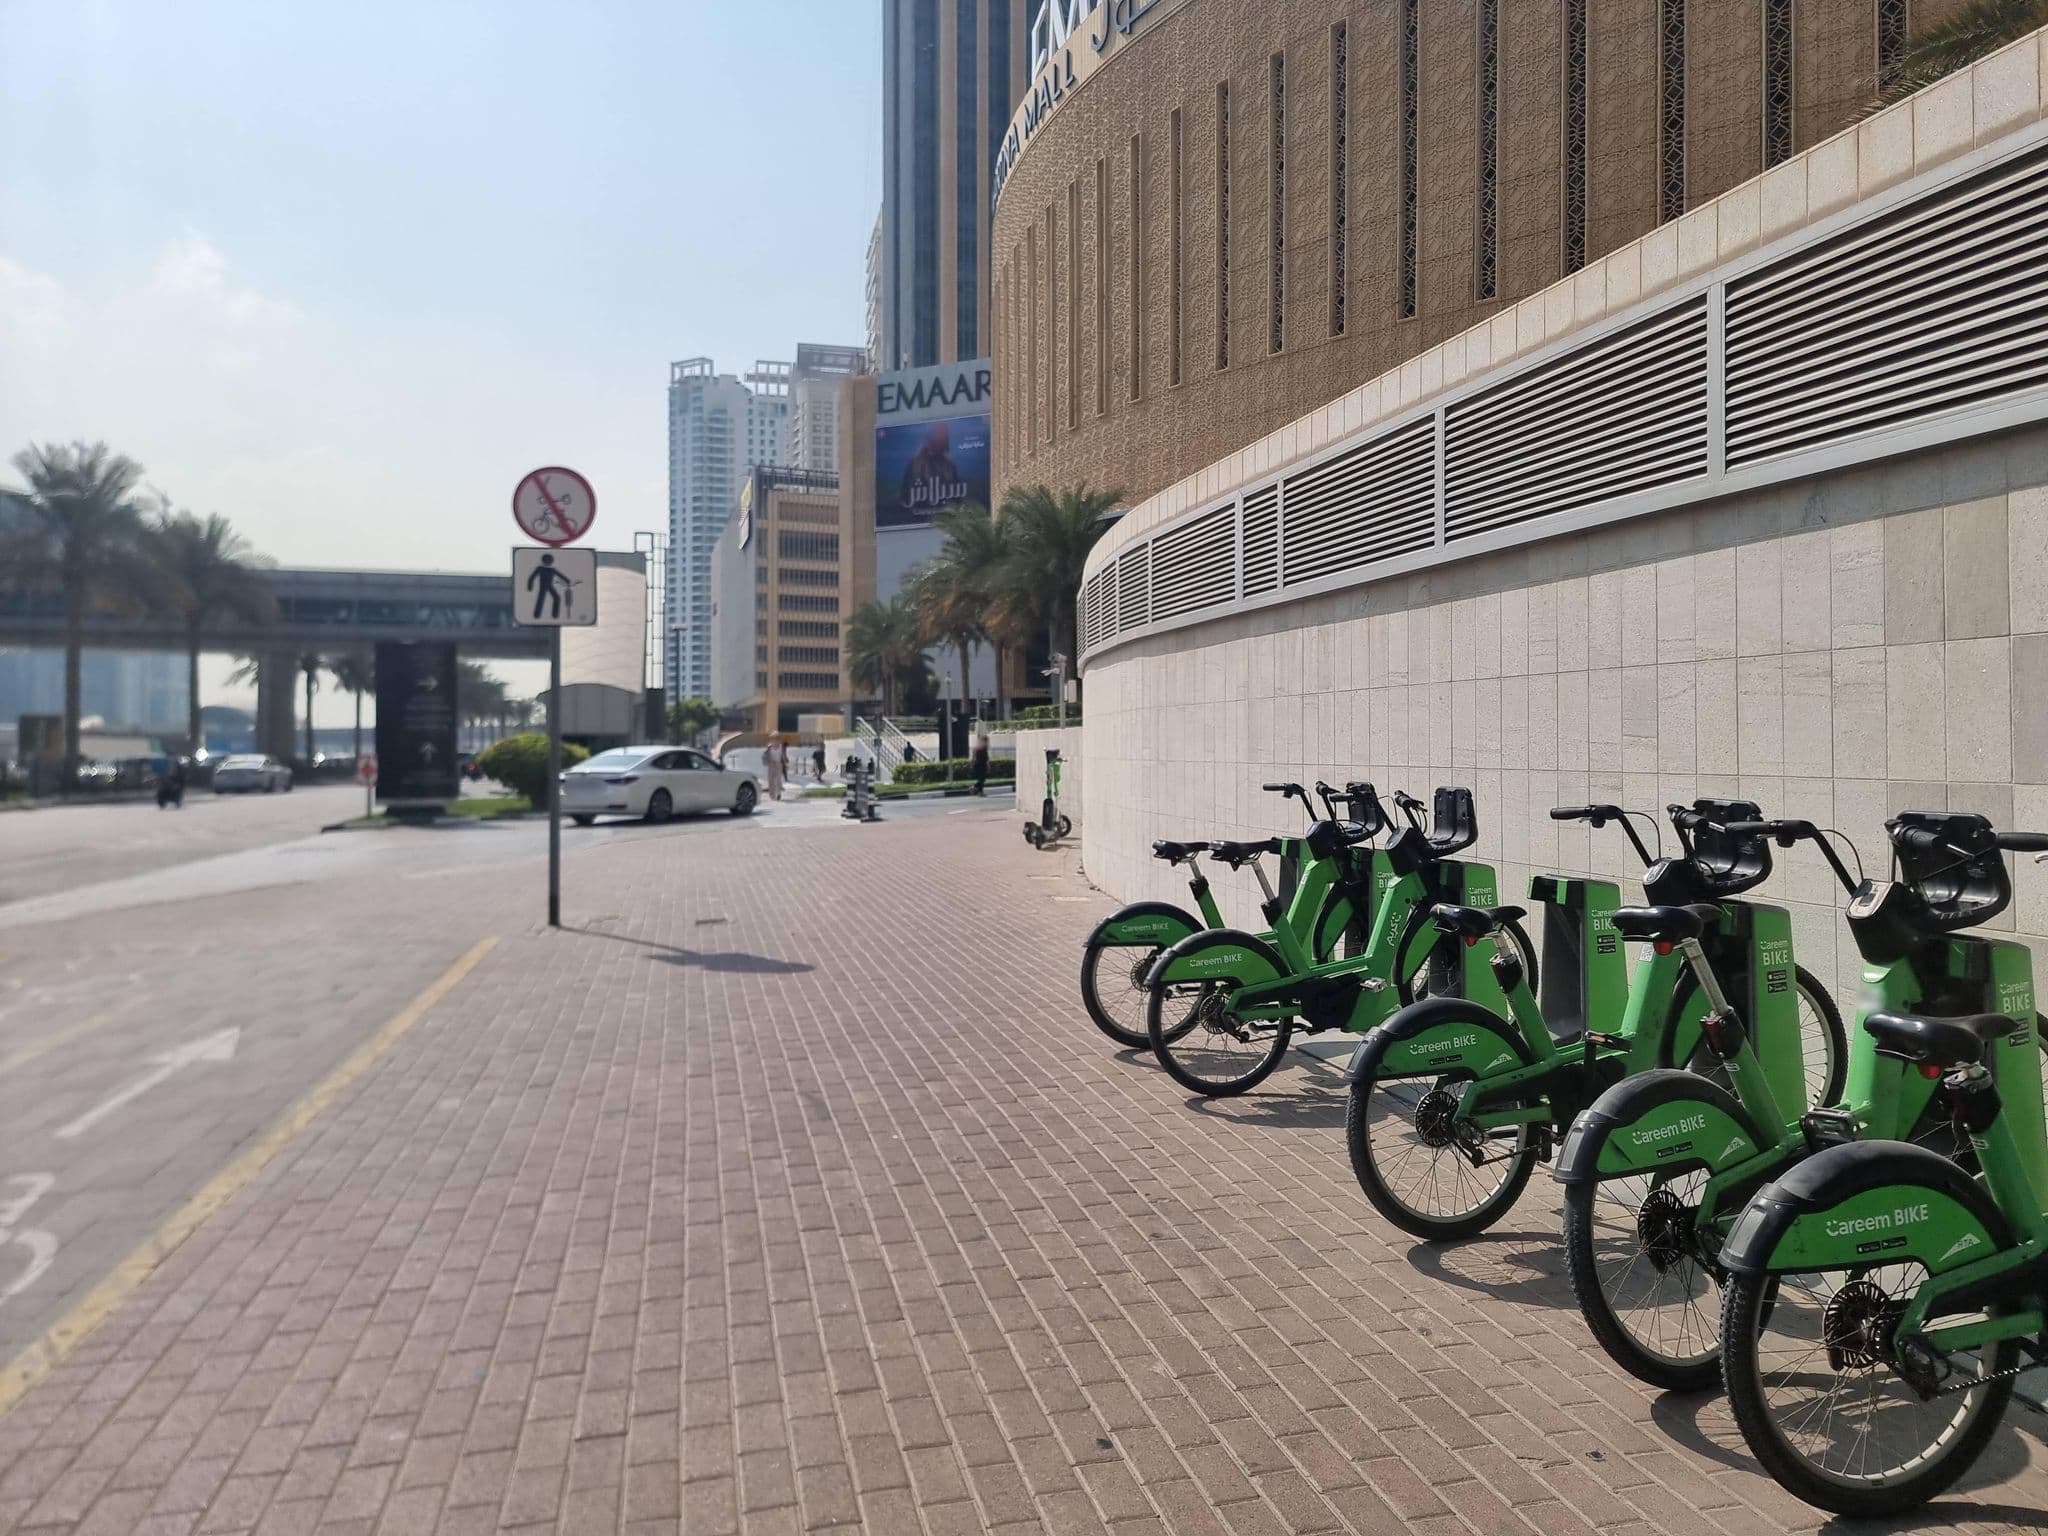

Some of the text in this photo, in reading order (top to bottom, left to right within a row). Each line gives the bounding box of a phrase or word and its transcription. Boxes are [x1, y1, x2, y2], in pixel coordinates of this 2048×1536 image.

[1023, 48, 1075, 139] MALL
[877, 370, 991, 414] EMAAR
[1376, 871, 1395, 879] Caree
[1470, 895, 1493, 906] BIKE
[1591, 910, 1616, 918] Caree
[1121, 922, 1169, 933] Careem BIKE
[1593, 918, 1616, 930] BIK
[1189, 953, 1243, 968] Careem BIKE
[1763, 950, 1789, 966] BIKE
[2002, 993, 2031, 1014] BIKE
[1409, 1034, 1477, 1055] Careem BIKE
[1632, 1114, 1706, 1145] Careem BIKE
[1826, 1203, 1929, 1237] Careem BIKE
